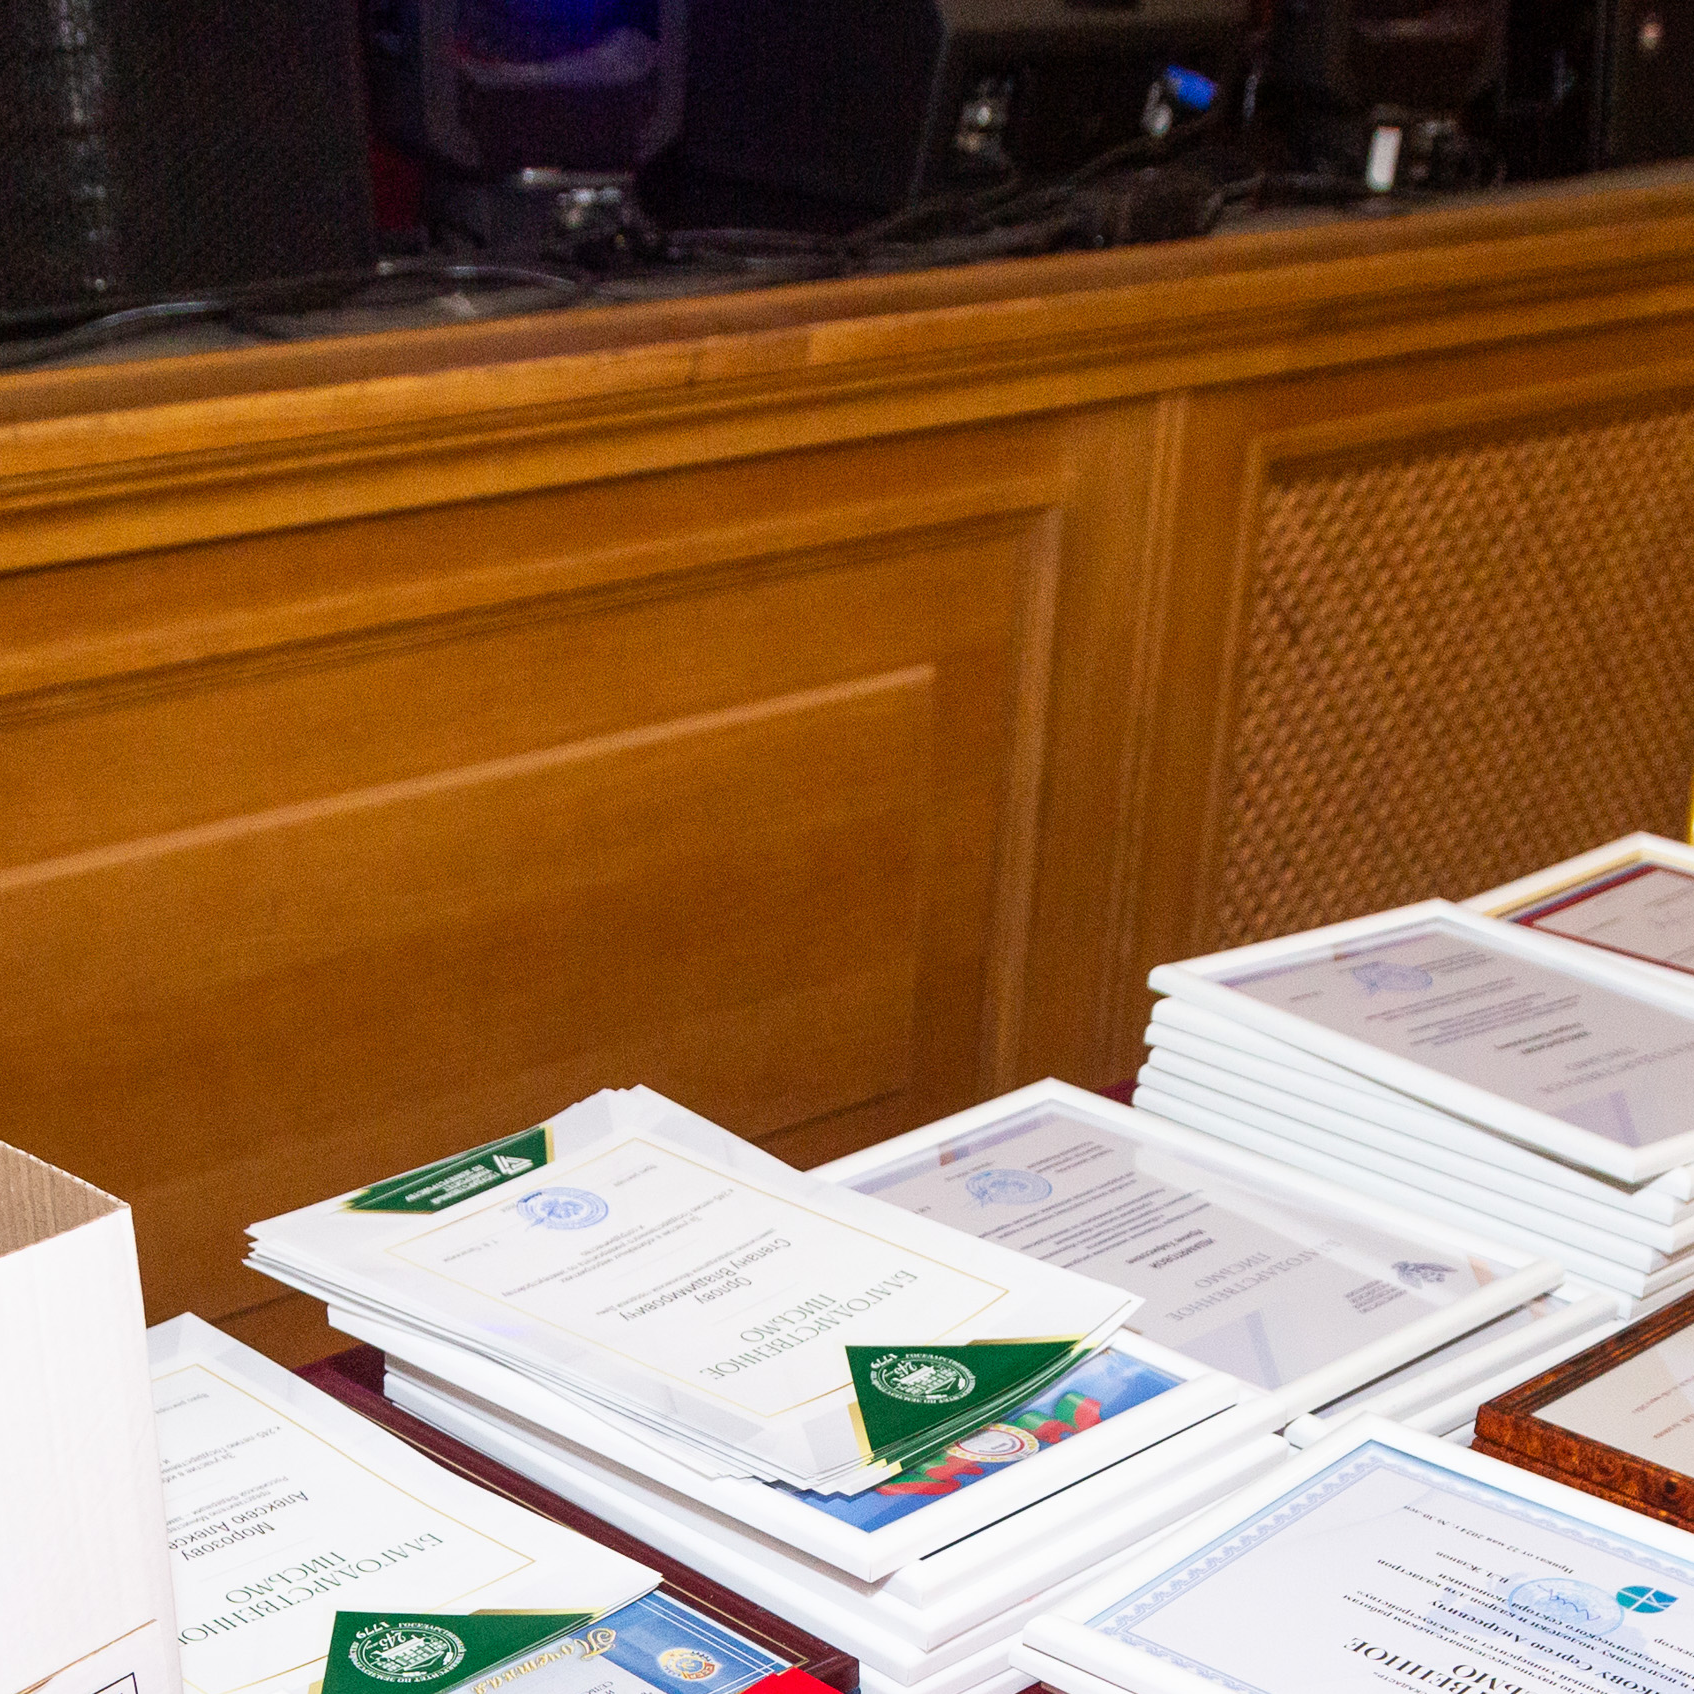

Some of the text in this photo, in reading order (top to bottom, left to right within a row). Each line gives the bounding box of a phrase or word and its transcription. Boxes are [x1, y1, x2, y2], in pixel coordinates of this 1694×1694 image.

[697, 1268, 919, 1381] БЛАГОДАРСТВЕННОЕ
[738, 1292, 838, 1343] ПИСЬМО
[870, 1353, 898, 1369] 1779
[894, 1361, 917, 1378] 245
[223, 1550, 347, 1604] ПИСЬМО
[355, 1621, 390, 1639] 1779
[1430, 1599, 1528, 1643] Андреевичу
[379, 1630, 406, 1651] 245
[1528, 1640, 1594, 1672] Сергею
